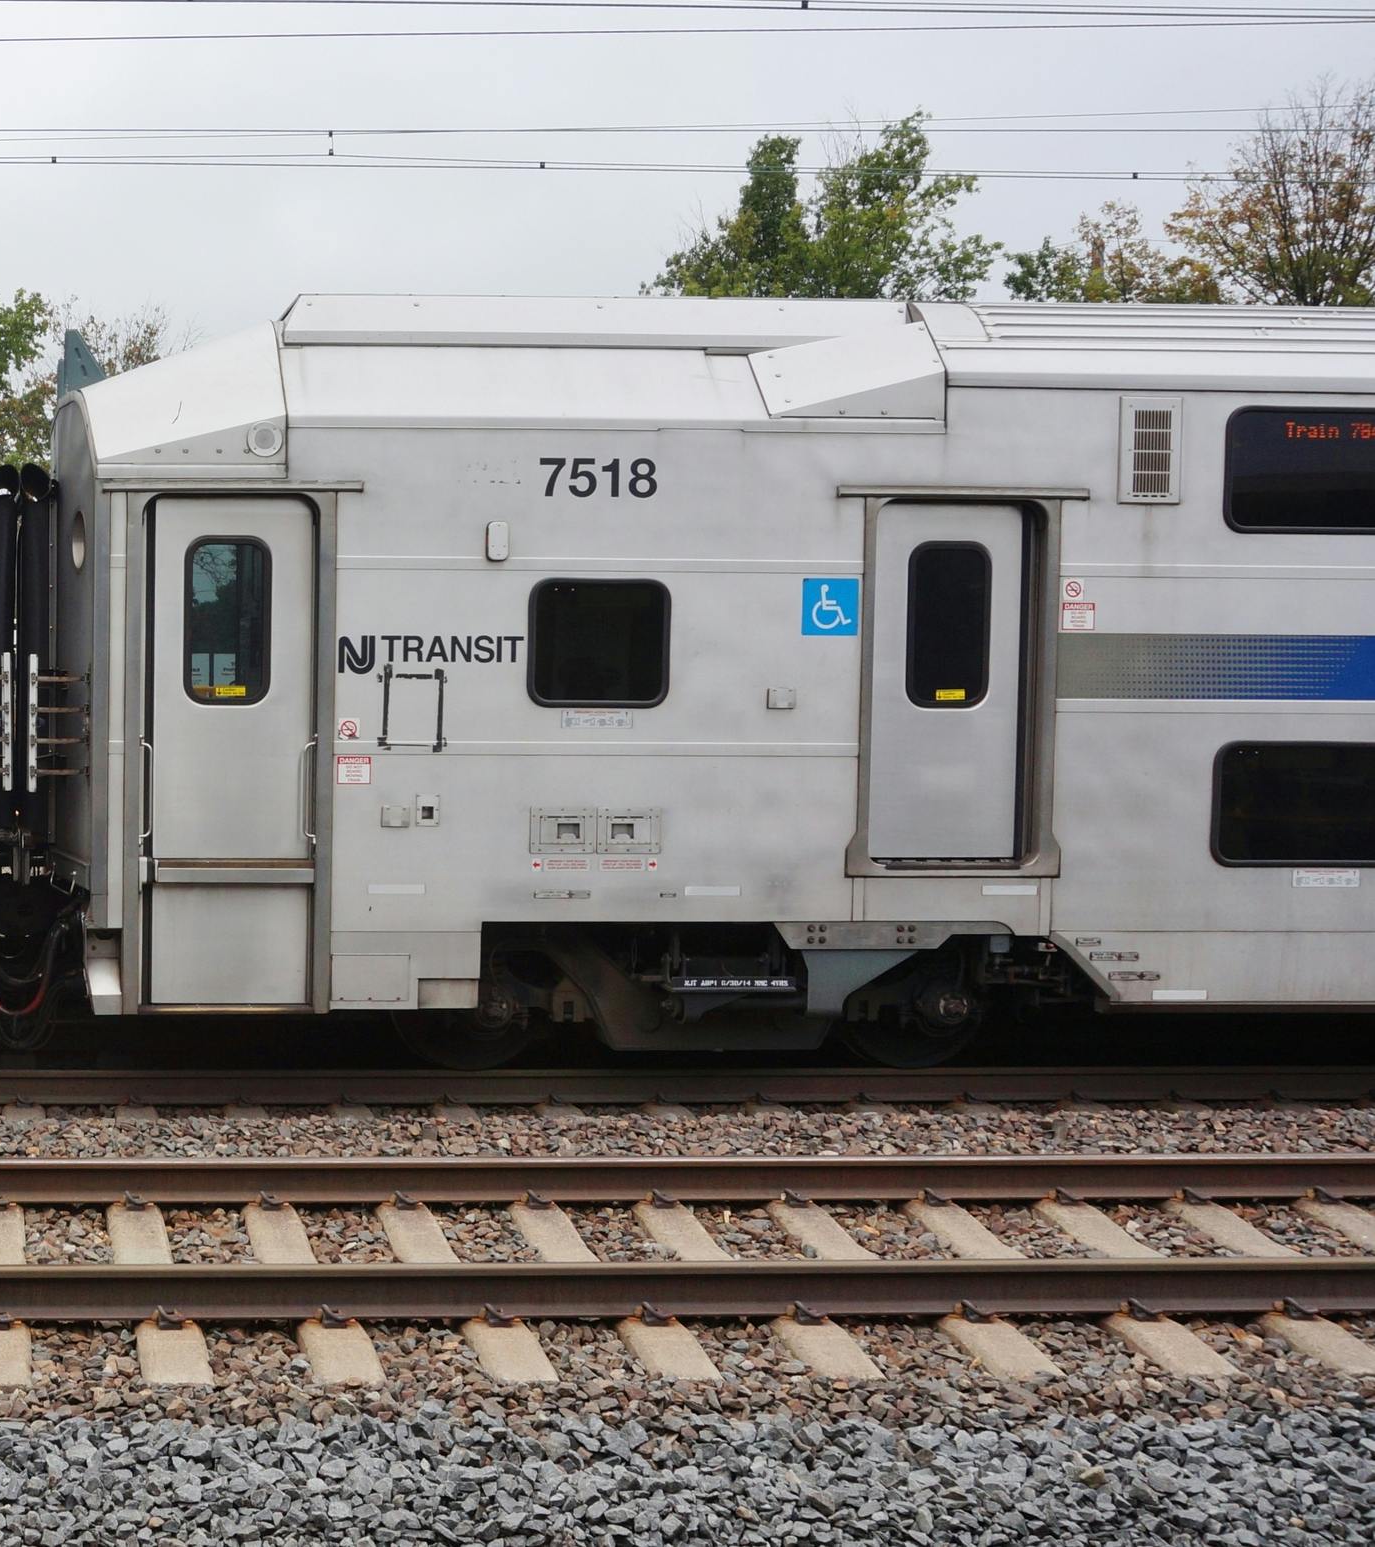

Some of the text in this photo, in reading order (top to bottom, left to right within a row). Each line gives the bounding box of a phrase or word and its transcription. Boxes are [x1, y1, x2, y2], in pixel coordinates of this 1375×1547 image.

[1285, 422, 1375, 438] Train 78
[539, 457, 658, 498] 7518
[338, 635, 524, 674] NJ TRANSIT
